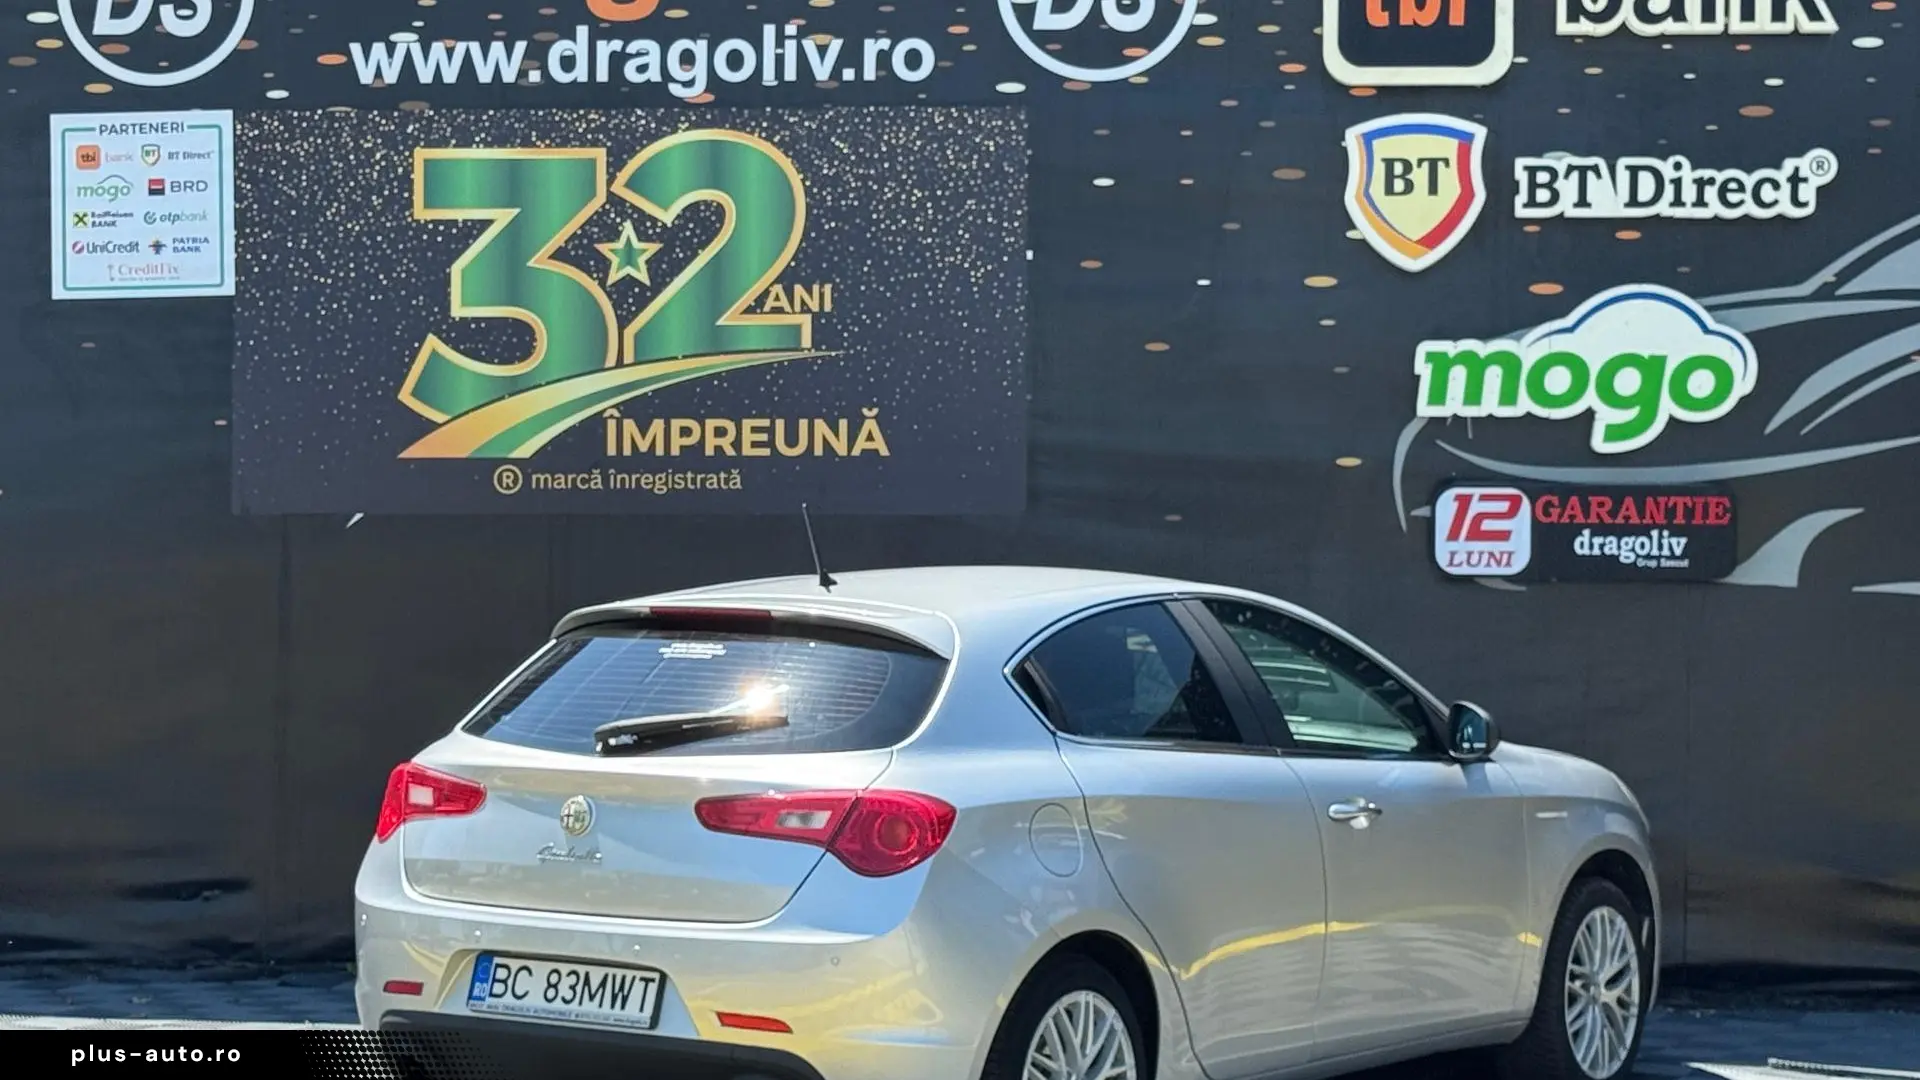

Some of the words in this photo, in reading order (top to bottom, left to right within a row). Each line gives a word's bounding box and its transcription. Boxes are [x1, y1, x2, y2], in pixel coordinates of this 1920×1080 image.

[348, 24, 936, 98] www.dragoliv.ro
[99, 121, 185, 136] PARTENERI
[80, 153, 97, 163] tbi
[105, 151, 135, 163] bank
[169, 180, 209, 194] BRD
[1382, 158, 1450, 197] BT
[1522, 164, 1602, 209] BT
[76, 184, 132, 203] mogo
[86, 240, 140, 255] UniCredit
[172, 236, 211, 245] PATRIA
[172, 245, 202, 254] BANK
[397, 129, 813, 424] 32
[763, 284, 833, 312] ANI
[1424, 350, 1735, 443] mogo
[604, 407, 891, 458] ÎMPREUNĂ
[531, 468, 603, 491] marcă
[608, 466, 742, 494] înregistrată
[1446, 494, 1523, 543] 12
[1534, 495, 1732, 525] GARANTIE
[1446, 550, 1513, 568] LUNI
[1573, 528, 1688, 565] dragoliv
[473, 982, 488, 997] RO
[488, 963, 534, 1001] BC
